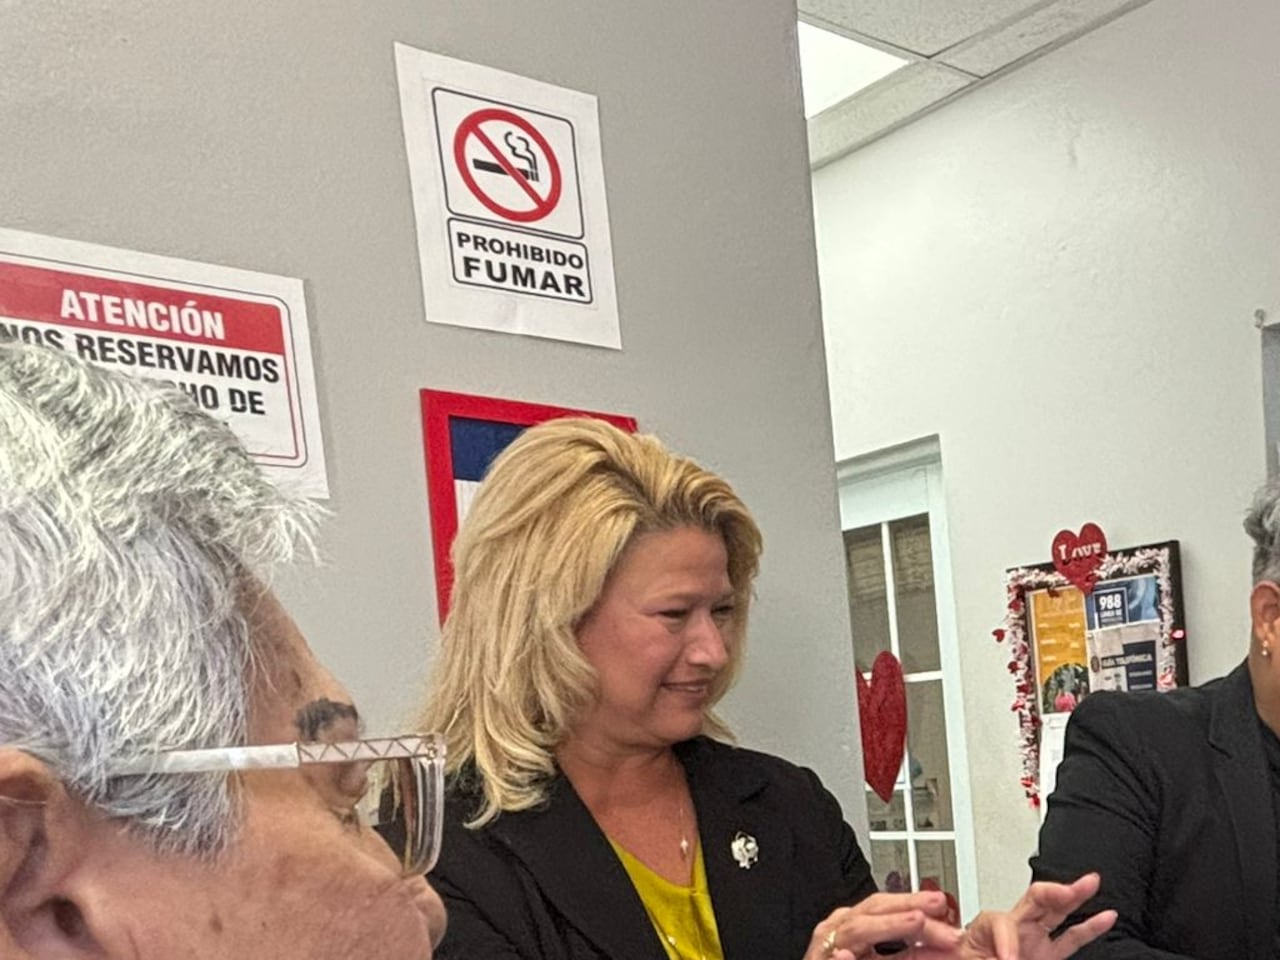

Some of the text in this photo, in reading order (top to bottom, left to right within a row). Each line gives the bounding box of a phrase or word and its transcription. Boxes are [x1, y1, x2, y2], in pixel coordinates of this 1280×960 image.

[456, 231, 584, 270] PROHIBIDO
[462, 255, 586, 298] FUMAR
[60, 288, 226, 341] ATENCIÓN
[73, 332, 281, 384] RESERVAMOS
[228, 386, 267, 415] DE
[1099, 593, 1122, 611] 988
